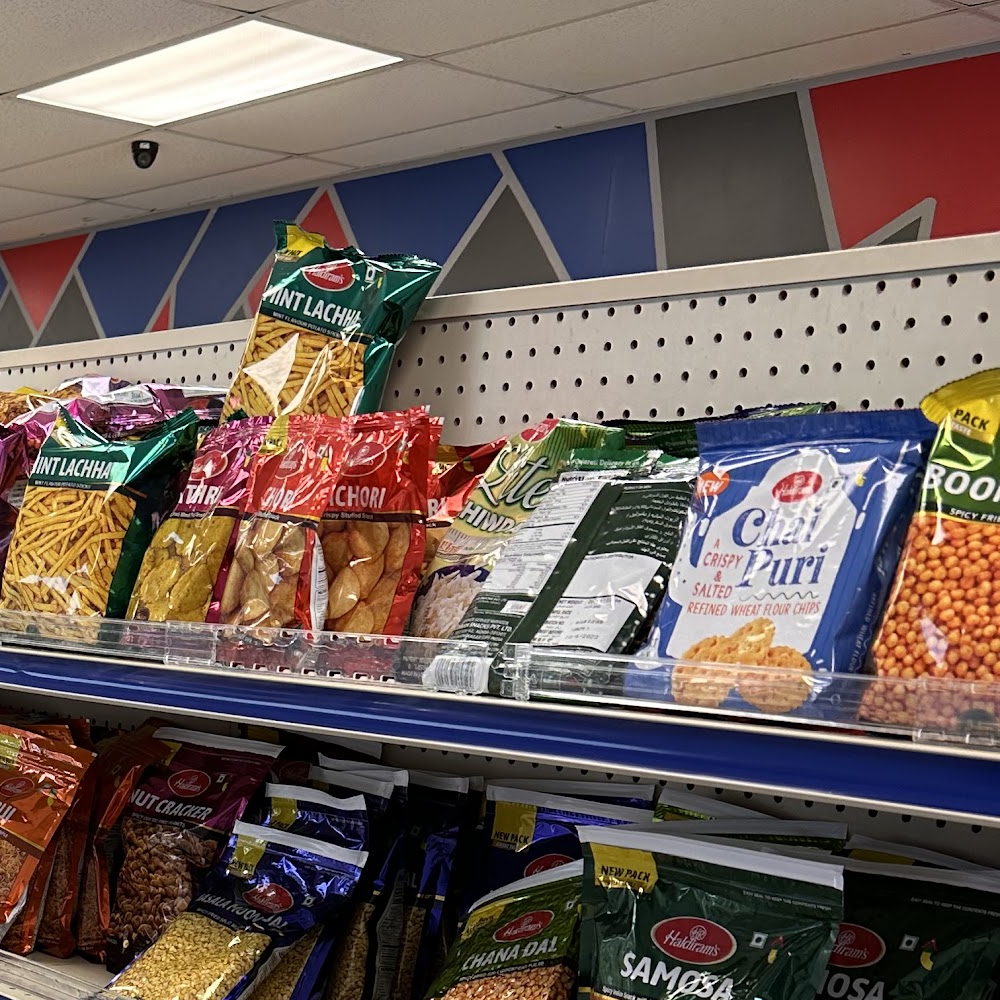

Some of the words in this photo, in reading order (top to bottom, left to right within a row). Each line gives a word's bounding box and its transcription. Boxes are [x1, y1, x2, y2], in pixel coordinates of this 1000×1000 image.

[954, 408, 990, 431] PACK
[59, 457, 113, 479] LACHHA
[950, 508, 977, 519] SPICY
[732, 505, 822, 547] Chai
[714, 539, 720, 549] A
[703, 552, 744, 569] CRISPY
[735, 545, 828, 587] Puri
[714, 571, 722, 582] &
[692, 582, 732, 599] SALTED
[687, 602, 728, 616] REFINED
[731, 603, 762, 616] WHEAT
[763, 603, 791, 616] FLOUR
[793, 601, 821, 615] CHIPS
[130, 788, 160, 809] NUT
[155, 800, 213, 820] CRACKER
[494, 831, 508, 842] NEW
[511, 832, 529, 844] PACK
[601, 865, 624, 878] NEW
[626, 869, 651, 882] PACK
[662, 929, 721, 957] Haldiram's
[462, 944, 521, 971] CHANA
[522, 936, 558, 957] DAL
